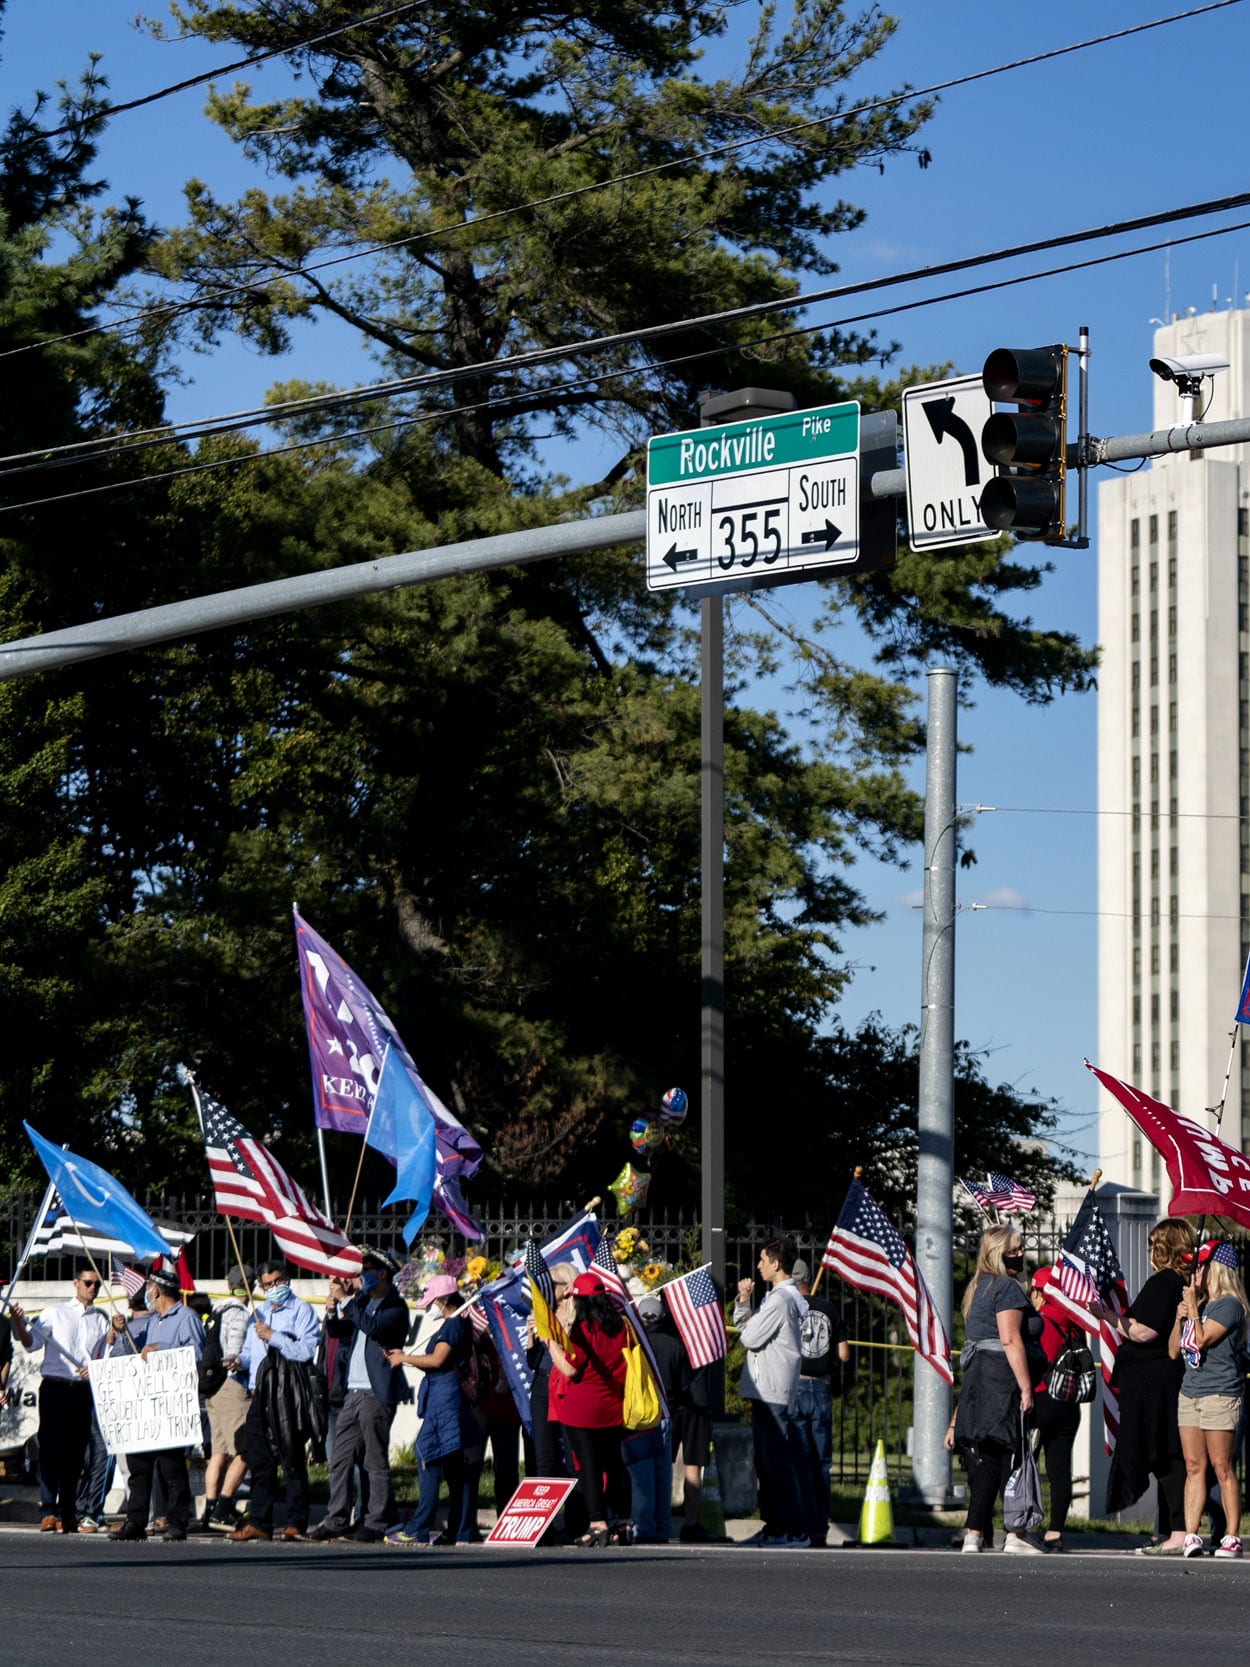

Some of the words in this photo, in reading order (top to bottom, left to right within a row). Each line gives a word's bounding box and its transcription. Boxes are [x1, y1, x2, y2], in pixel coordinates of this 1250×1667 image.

[679, 426, 775, 475] Rockville
[802, 416, 831, 437] Pike
[799, 474, 846, 512] SOUTH
[658, 498, 702, 534] NORTH
[924, 495, 981, 531] ONLY
[718, 508, 781, 570] 355
[97, 1380, 123, 1402] GET
[132, 1375, 169, 1398] WELL
[151, 1392, 194, 1416] TRUMP
[167, 1413, 201, 1438] TRUMP
[494, 1515, 547, 1539] TRUMP
